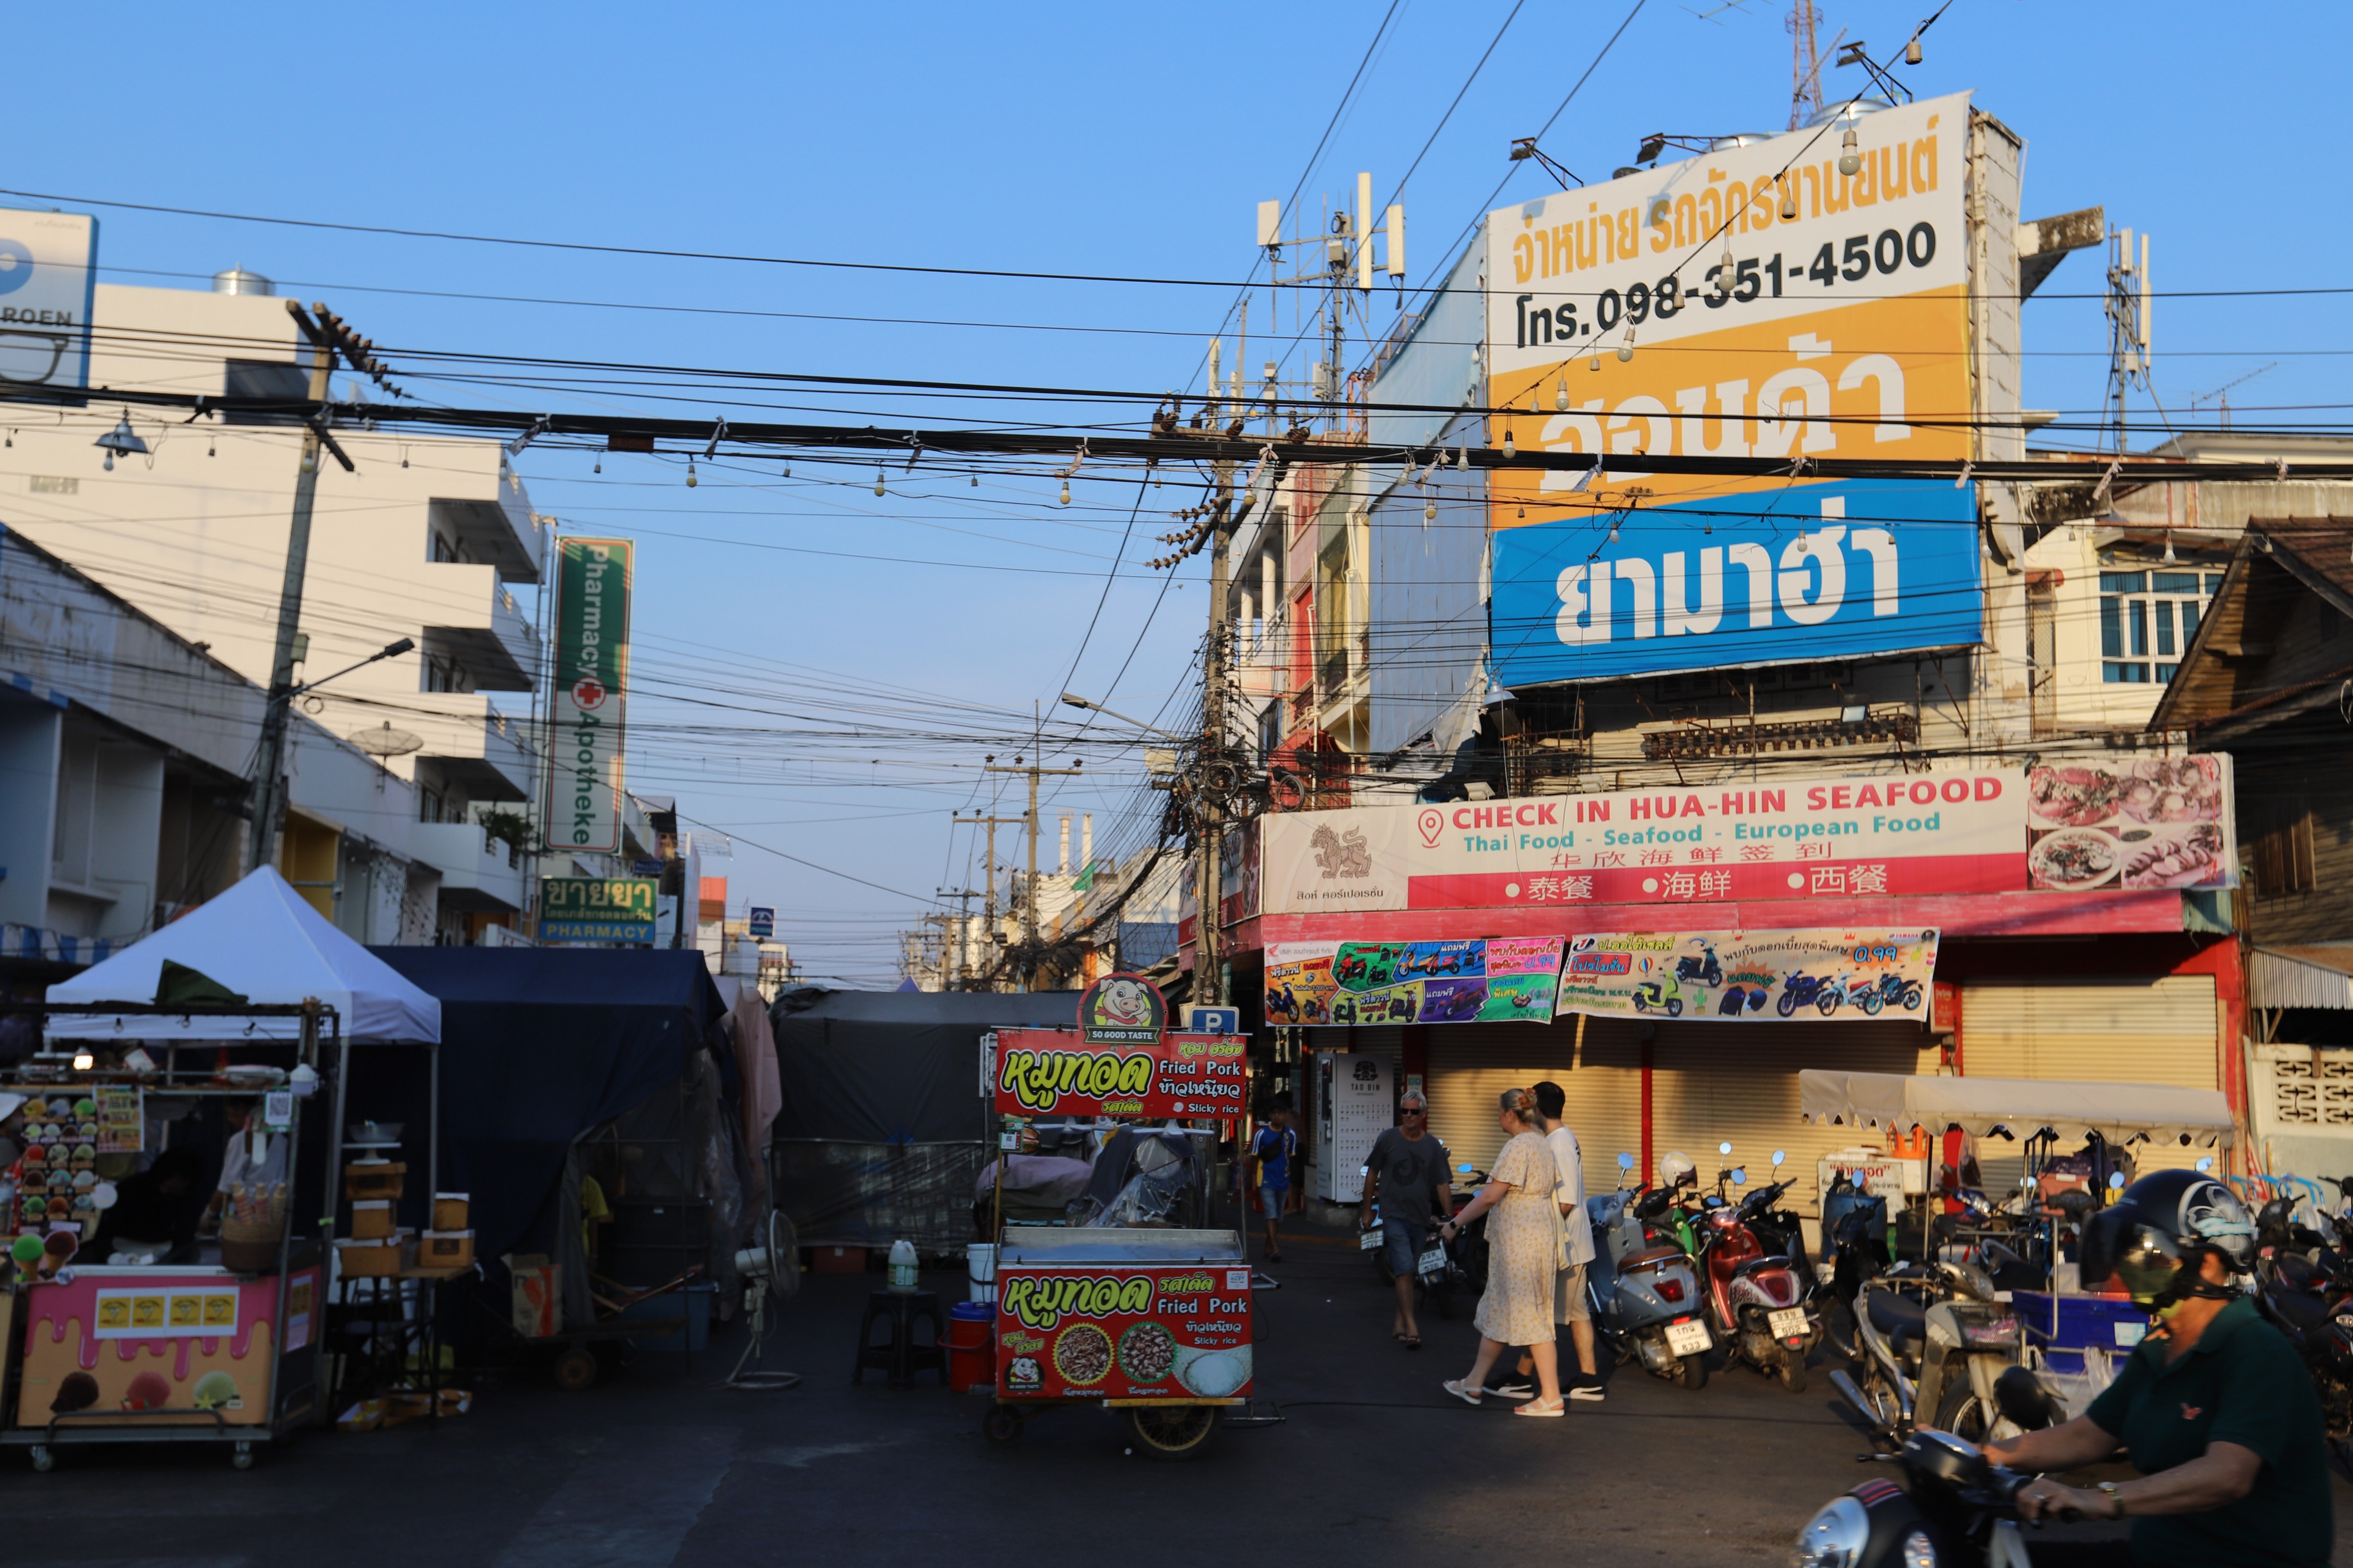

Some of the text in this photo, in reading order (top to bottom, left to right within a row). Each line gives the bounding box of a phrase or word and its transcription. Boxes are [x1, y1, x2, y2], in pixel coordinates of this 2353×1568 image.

[1513, 113, 1939, 284] จำหน่าย รถจักรยานยนต์
[1554, 496, 1898, 647] ยามาฮ่า
[576, 545, 609, 676] Pharmacy
[573, 711, 601, 845] Apotheke
[1453, 777, 2003, 829] CHECK IN HUA-HIN SEAFOOD
[1464, 835, 1508, 852] Thai
[1520, 831, 1574, 849] Food
[1603, 825, 1703, 846] Seafood
[1735, 820, 1859, 841] European
[1873, 812, 1940, 833] Food
[1551, 841, 1833, 869] 华欣海鲜签到
[1528, 874, 1593, 901] 泰餐
[1662, 870, 1732, 899] 海鲜
[1810, 864, 1888, 894] 西餐
[547, 881, 652, 908] ขายยา
[1297, 889, 1318, 900] สิงห์
[547, 923, 648, 939] PHARMACY
[1441, 941, 1471, 952] แถมฟรี
[1724, 935, 1849, 961] พบกับดอกเบี้ยสุดพิเศษ
[1853, 946, 1898, 963] 0.99
[1573, 956, 1625, 973] โปรโมชั่น
[1727, 972, 1776, 989] แถมฟรี
[1426, 987, 1455, 998] แถมฟรี
[1206, 1013, 1222, 1033] P
[1179, 1039, 1244, 1058] หอม อร่อย
[1159, 1060, 1241, 1076] Fried Pork
[1002, 1051, 1153, 1109] หมูทอด
[1158, 1078, 1240, 1098] ข้าวเหนียว
[1102, 1099, 1143, 1114] รสเด็ด
[1188, 1103, 1240, 1114] Sticky rice
[1159, 1273, 1215, 1295] รสเด็ด
[1004, 1277, 1149, 1329] หมูทอด
[1158, 1297, 1247, 1314] Fried Pork
[1186, 1320, 1242, 1333] ข้าวเหนียว
[1194, 1337, 1218, 1346] Sticky
